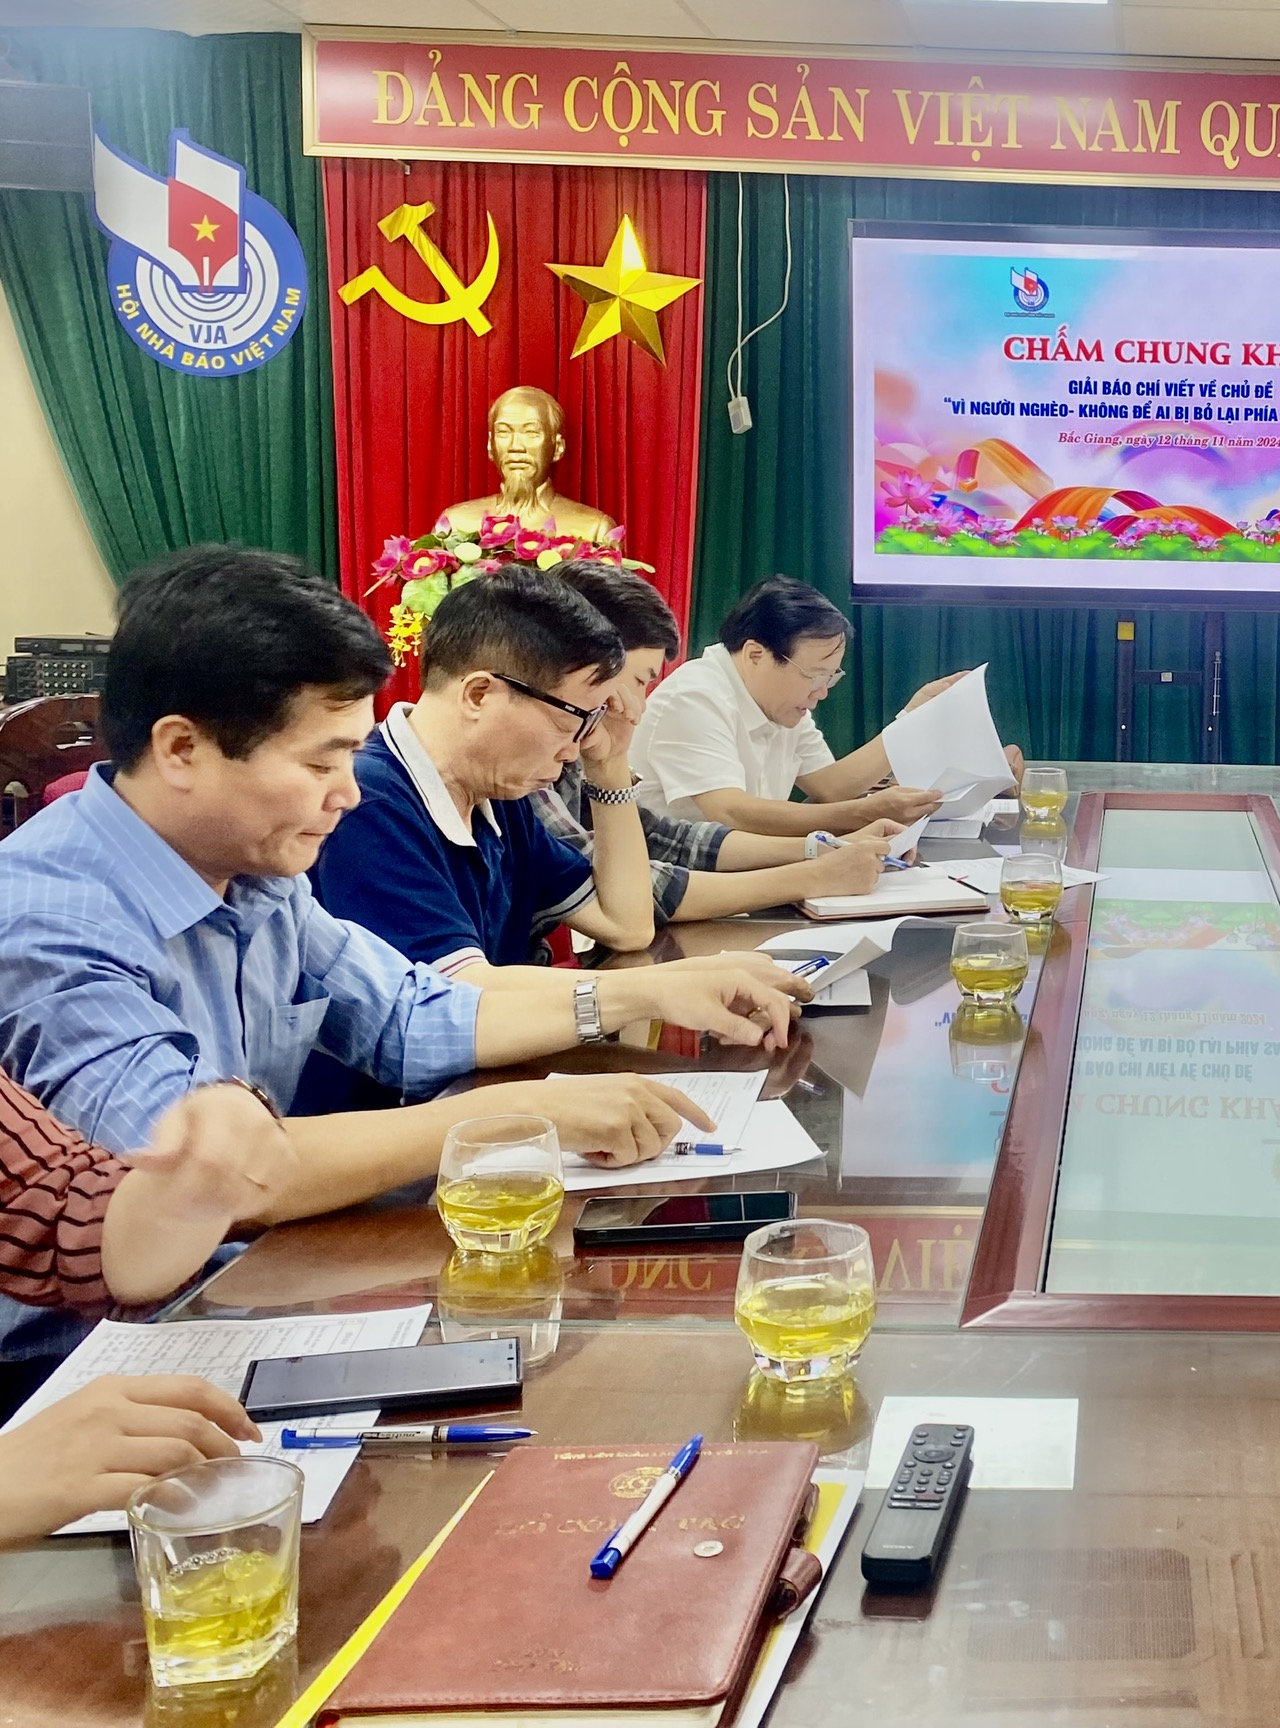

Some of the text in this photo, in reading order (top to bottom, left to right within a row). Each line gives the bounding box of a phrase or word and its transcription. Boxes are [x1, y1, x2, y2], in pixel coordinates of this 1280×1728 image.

[372, 49, 545, 129] ĐẢNG
[563, 61, 727, 148] CỘNG
[747, 63, 869, 142] SẢN
[892, 74, 1031, 162] VIỆT
[1051, 97, 1180, 155] NAM
[116, 284, 301, 369] HỘI NHÀ BÁO VIỆT NAM
[189, 324, 228, 344] VJA
[1004, 325, 1104, 362] CHẤM
[1114, 340, 1231, 365] CHUNG
[1068, 376, 1098, 395] GIẢI
[1102, 379, 1132, 396] BÁO
[1136, 379, 1160, 396] CHÍ
[1165, 378, 1195, 397] VIẾT
[1199, 379, 1217, 398] VỀ
[1221, 380, 1250, 398] CHỦ
[970, 400, 1015, 416] NGƯỜI
[1078, 402, 1128, 418] KHÔNG
[1132, 400, 1152, 419] ĐỂ
[1155, 406, 1170, 419] AI
[1175, 406, 1189, 423] BỊ
[1193, 403, 1213, 421] BỎ
[1217, 408, 1239, 423] LẠI
[1244, 405, 1278, 422] PHÍA
[1058, 431, 1080, 443] Bắc
[1084, 433, 1123, 446] Giang,
[1126, 434, 1154, 447] ngày
[1157, 435, 1170, 445] 12
[1174, 435, 1208, 448] tháng
[1211, 437, 1224, 446] 11
[1228, 437, 1253, 447] năm
